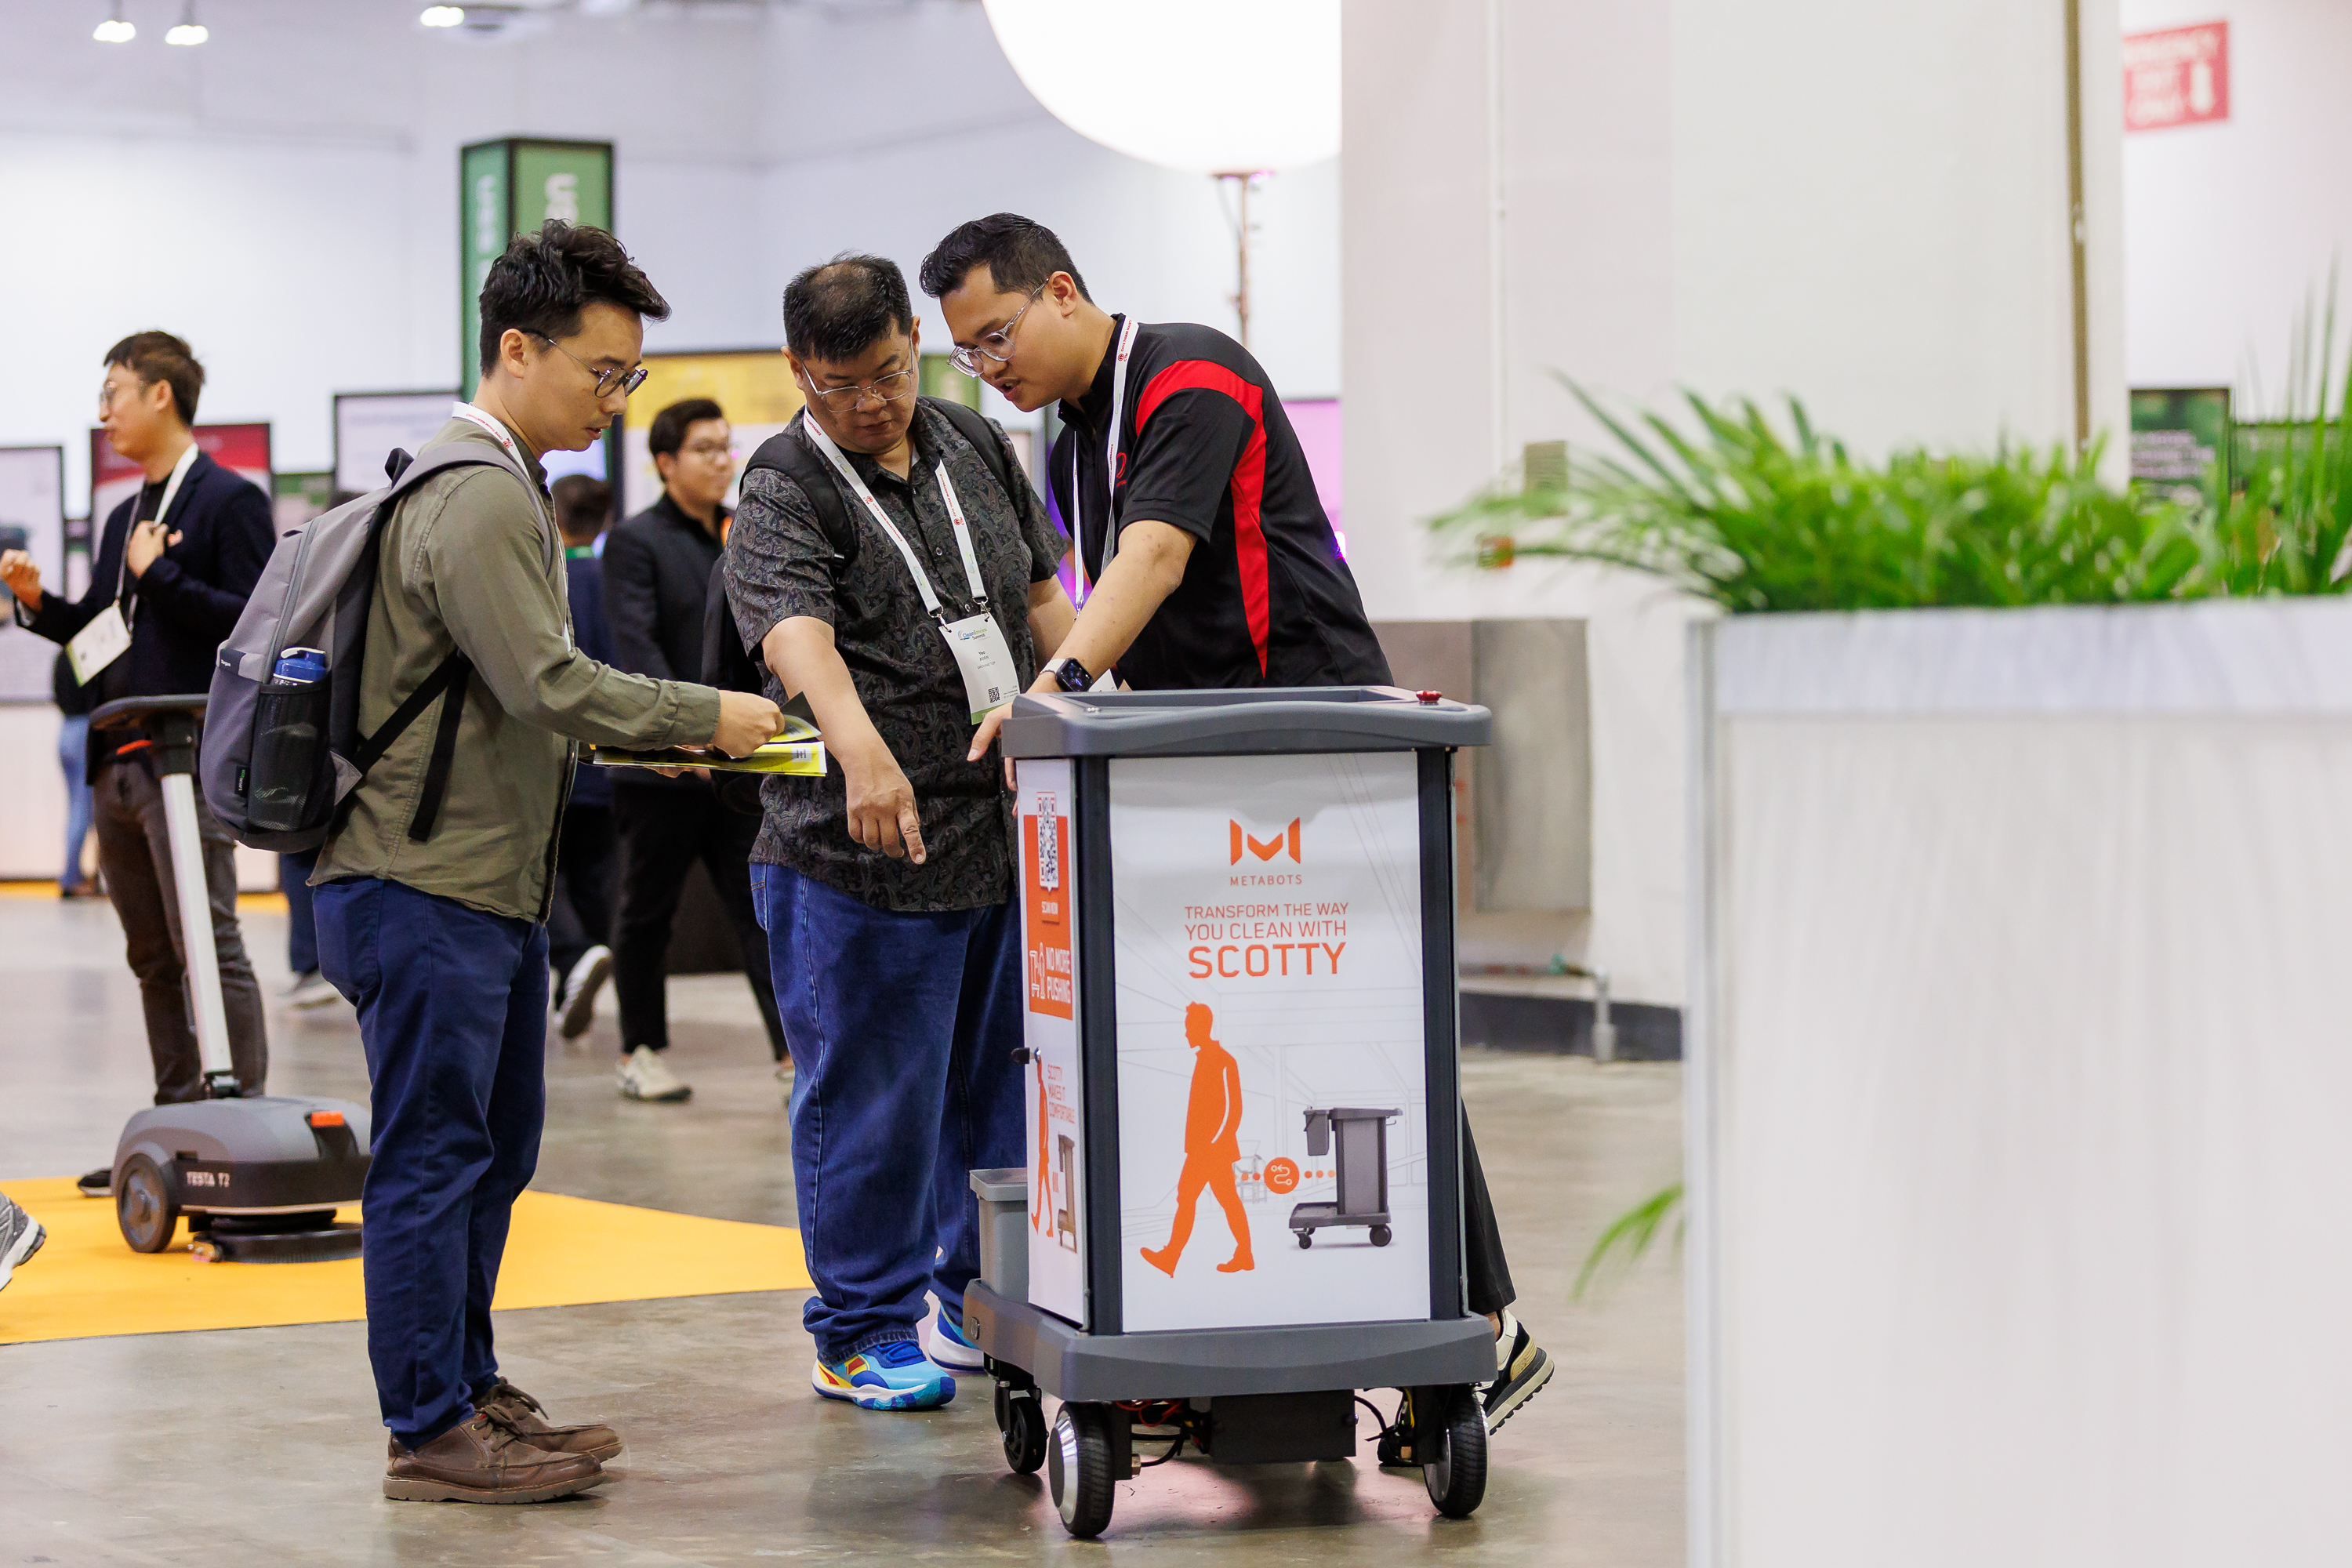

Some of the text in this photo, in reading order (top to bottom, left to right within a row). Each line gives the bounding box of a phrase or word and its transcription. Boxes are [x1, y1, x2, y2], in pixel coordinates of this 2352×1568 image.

[962, 628, 988, 638] CleanEnviro
[1230, 874, 1302, 886] METABOTS
[1185, 902, 1348, 920] TRANSFORM THE WAY
[1185, 920, 1346, 941] YOU CLEAN WITH
[1046, 946, 1071, 975] NO MORE
[1189, 942, 1347, 979] SCOTTY
[1047, 976, 1072, 1004] PUSHING
